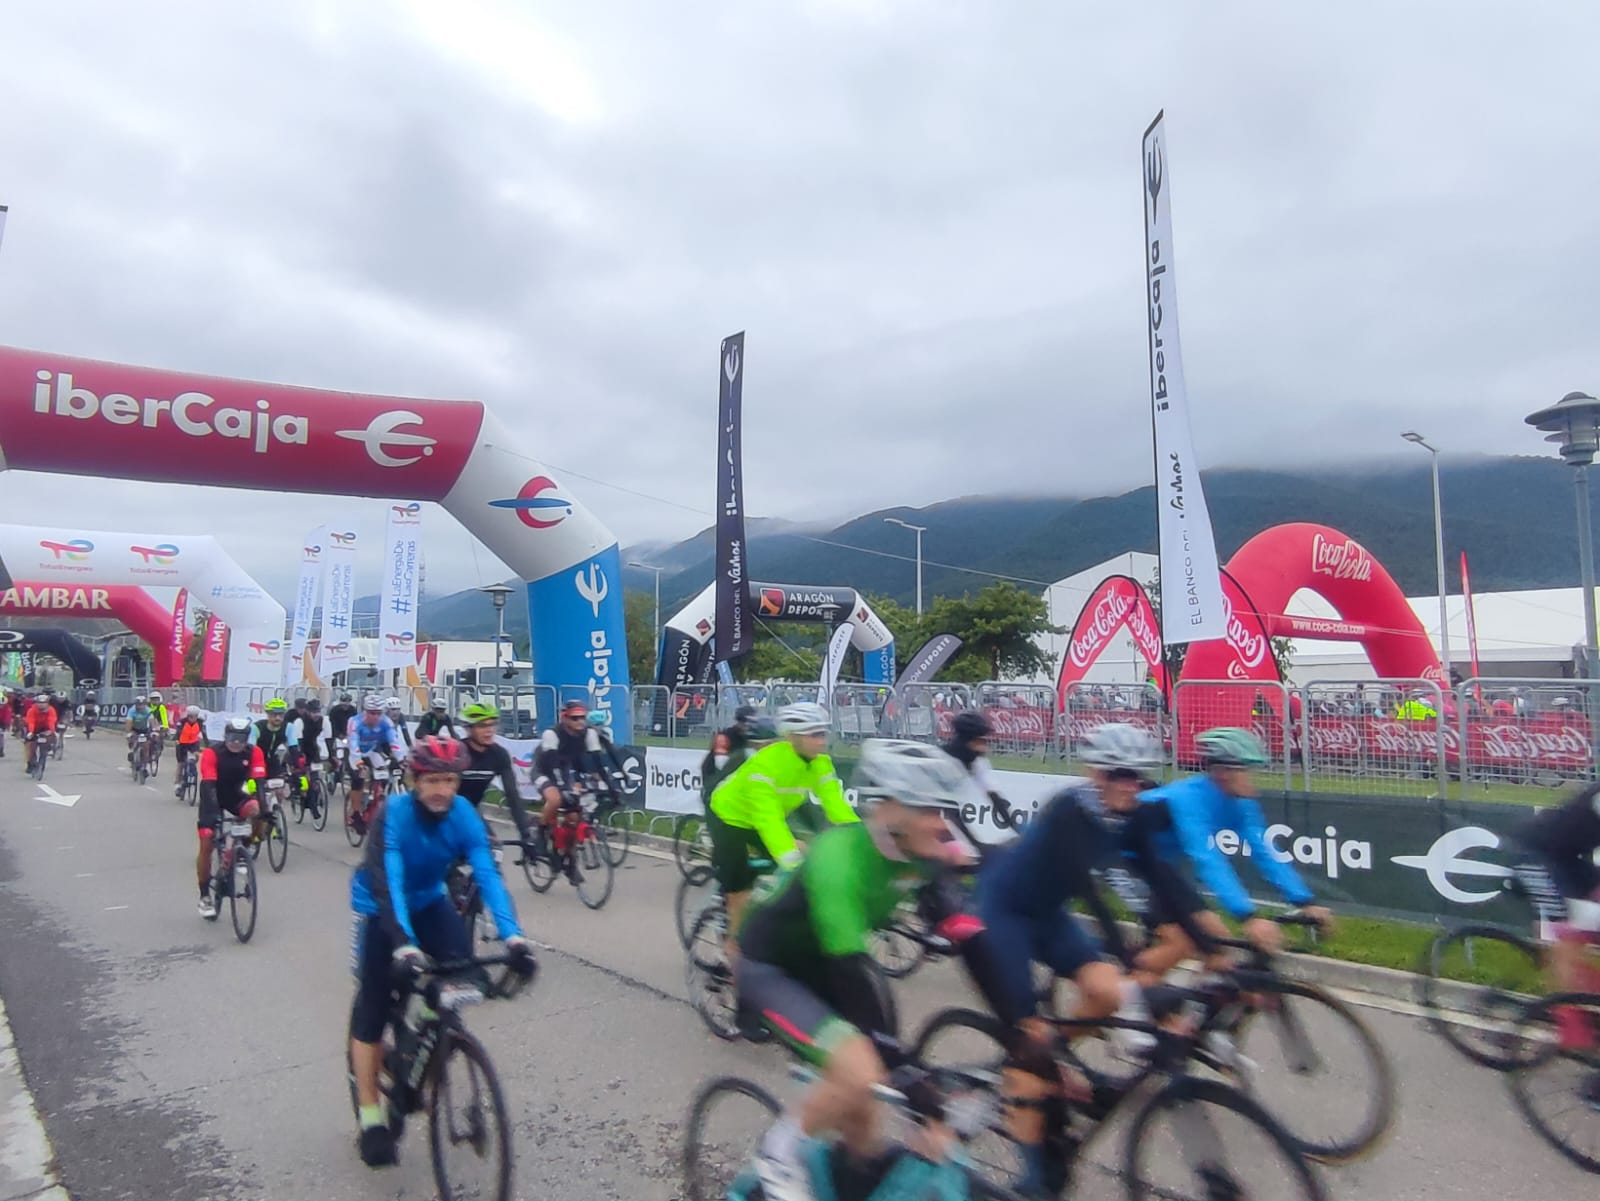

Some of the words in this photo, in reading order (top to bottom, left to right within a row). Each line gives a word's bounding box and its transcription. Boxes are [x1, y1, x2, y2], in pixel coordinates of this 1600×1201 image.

[1151, 239, 1169, 412] iberCaja
[33, 369, 309, 454] iberCaja
[788, 592, 834, 603] ARAGÓN
[1184, 557, 1199, 606] BANCO
[0, 586, 112, 610] AMBAR
[733, 604, 742, 637] BANCO
[1191, 608, 1203, 625] EL
[210, 621, 226, 652] AMB
[920, 637, 951, 671] DEPORTE
[651, 765, 701, 790] iberCa
